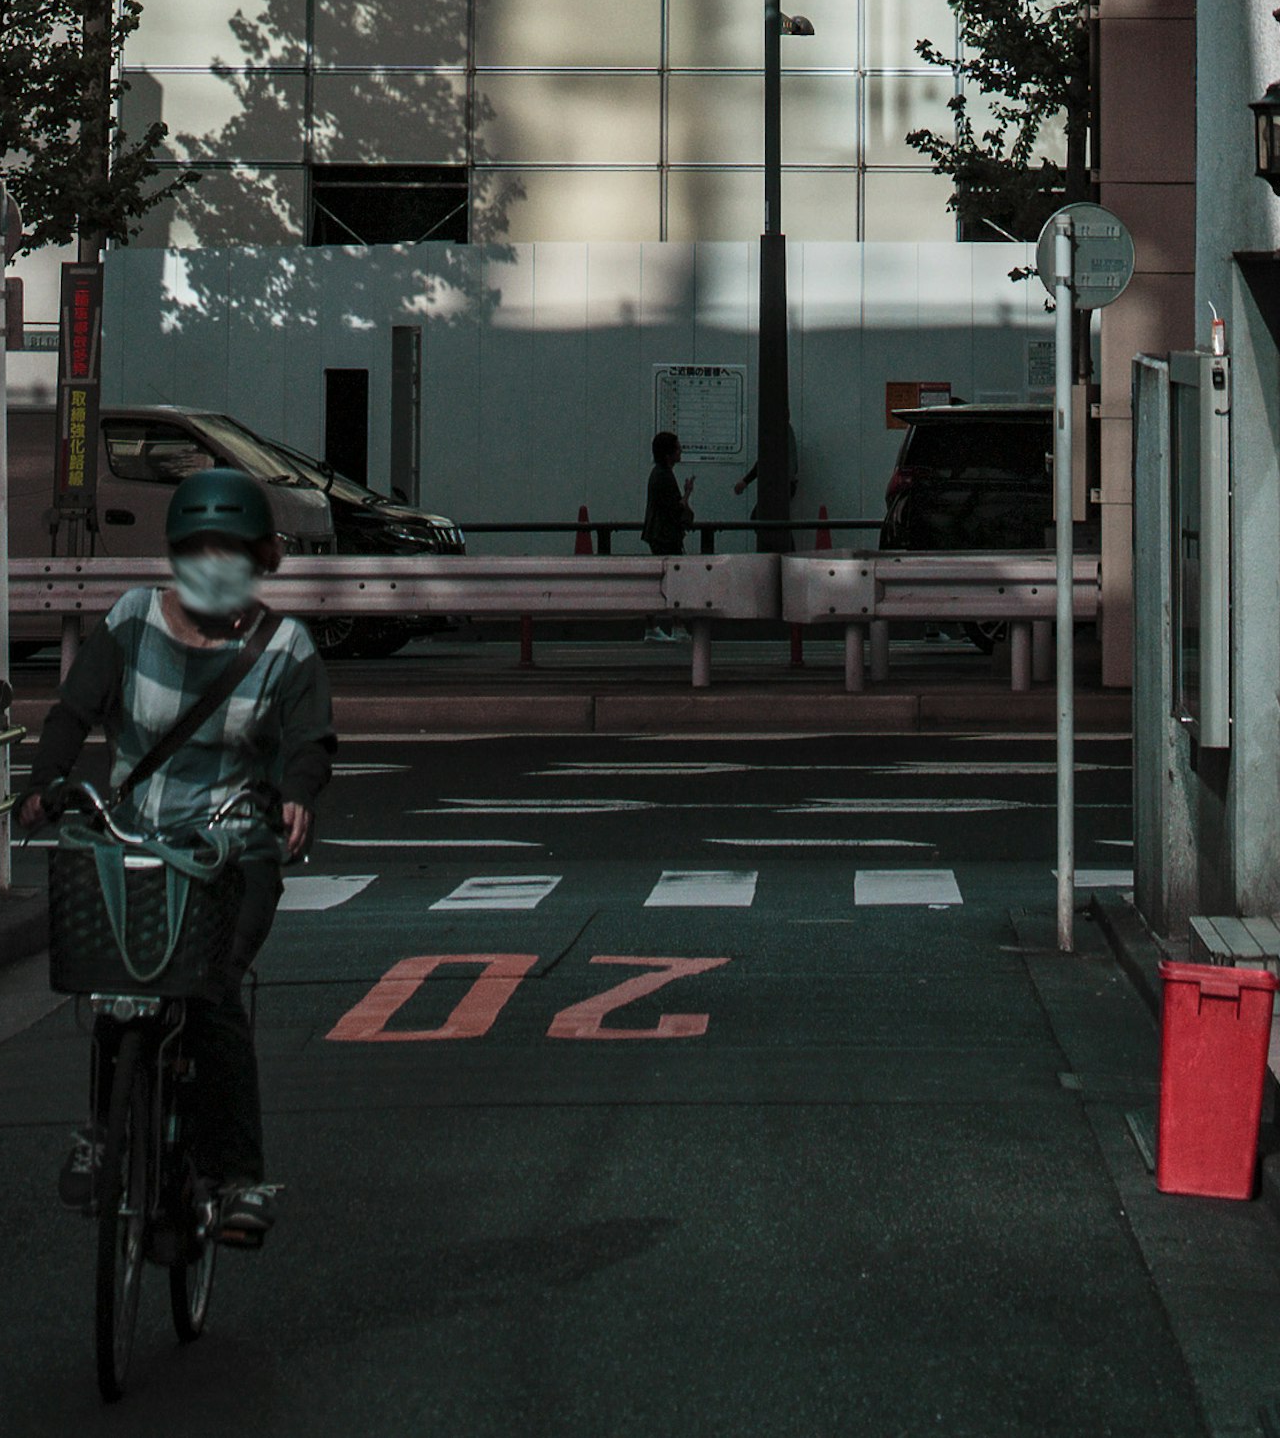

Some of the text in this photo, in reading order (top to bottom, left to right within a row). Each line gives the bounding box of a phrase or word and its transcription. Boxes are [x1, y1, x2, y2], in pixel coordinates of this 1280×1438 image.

[668, 366, 731, 377] ご近隣の皆様へ
[68, 390, 87, 486] 取締強化路線
